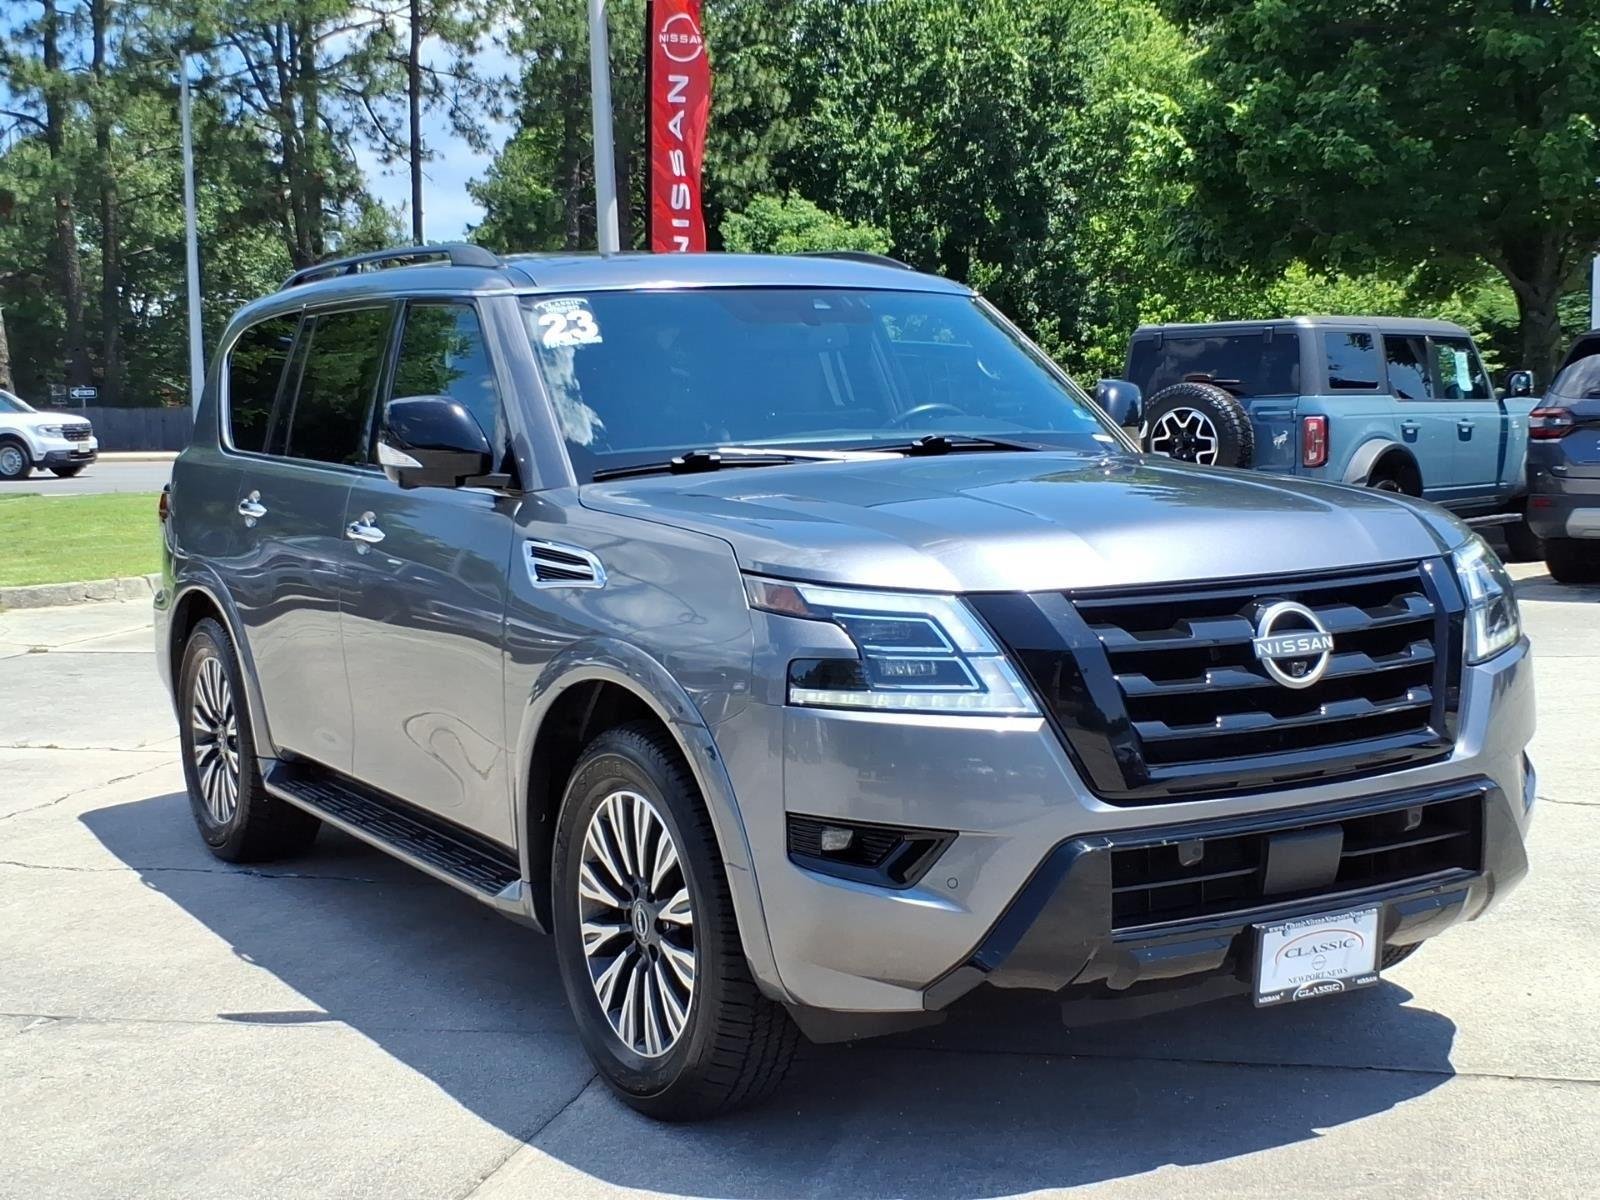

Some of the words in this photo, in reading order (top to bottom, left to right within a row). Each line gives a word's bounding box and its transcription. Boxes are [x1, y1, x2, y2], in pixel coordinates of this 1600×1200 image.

[659, 33, 702, 45] NISSAN
[538, 310, 599, 346] 23
[1256, 635, 1334, 656] NISSAN
[1284, 938, 1356, 959] CLASSIC
[1288, 970, 1325, 984] NEWPORT
[1327, 967, 1349, 977] NEWS
[1298, 983, 1341, 998] CLASSIC
